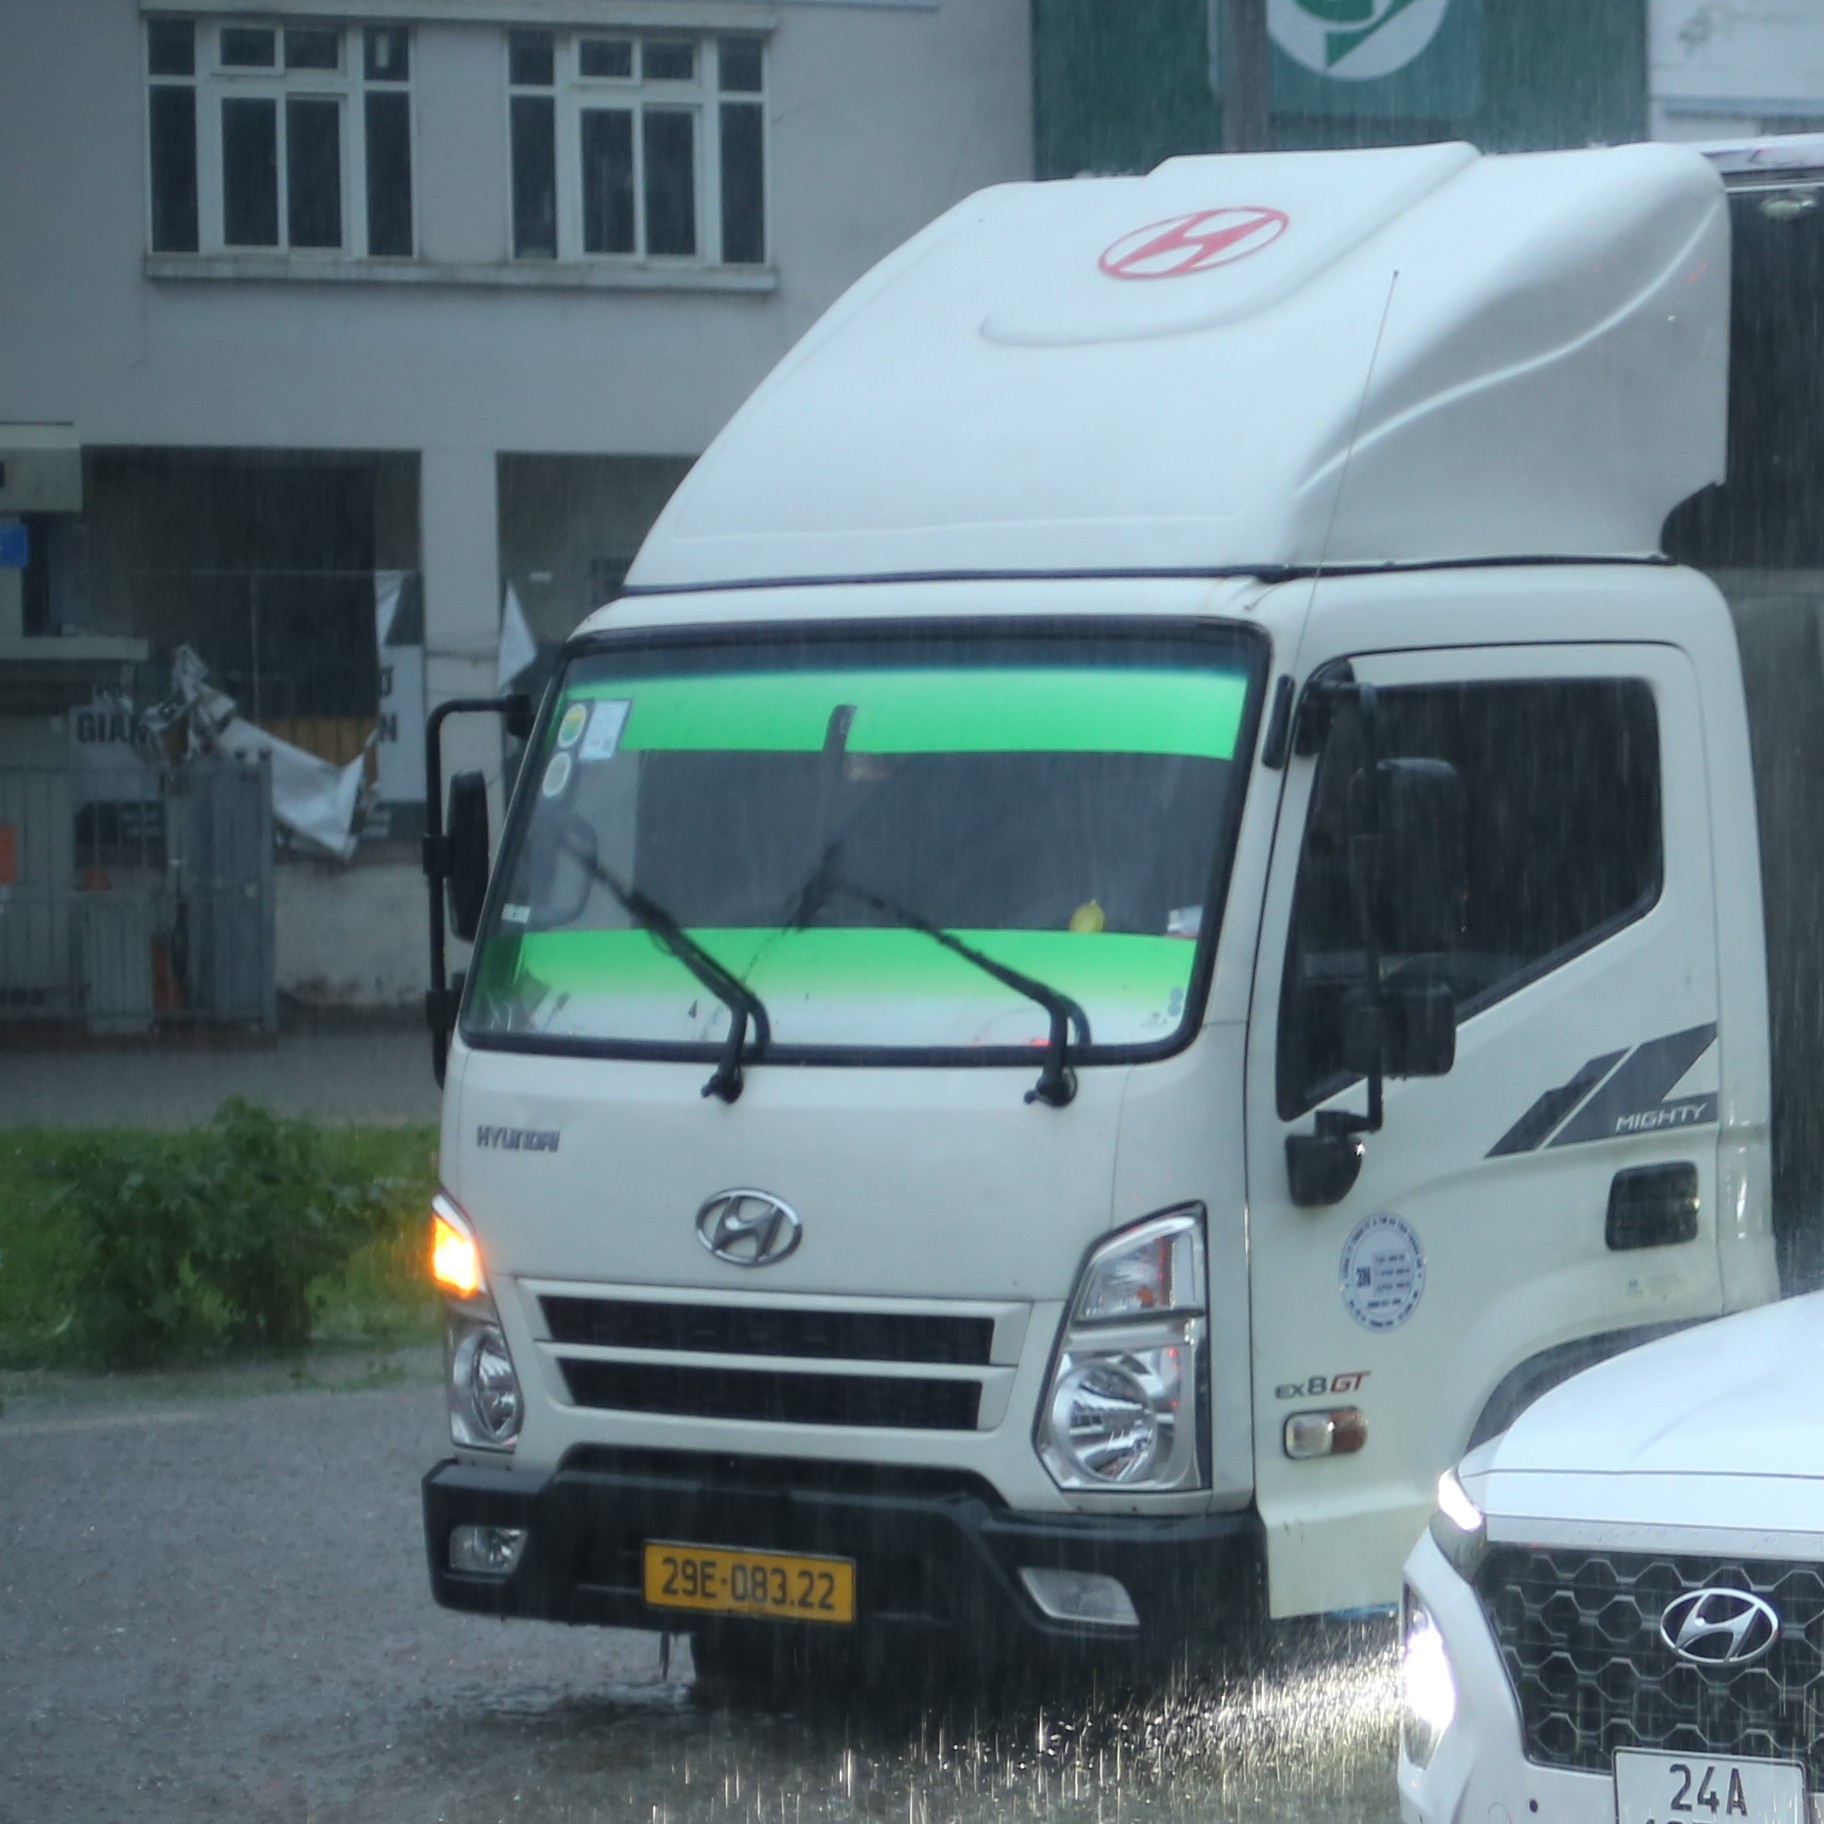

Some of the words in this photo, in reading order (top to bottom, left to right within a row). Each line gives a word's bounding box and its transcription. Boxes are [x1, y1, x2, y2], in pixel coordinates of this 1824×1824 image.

[477, 1125, 560, 1152] HYUNDAI
[1615, 1102, 1708, 1133] MIGHTY
[661, 1556, 836, 1611] 29E-083.22
[1669, 1763, 1749, 1816] 24A
